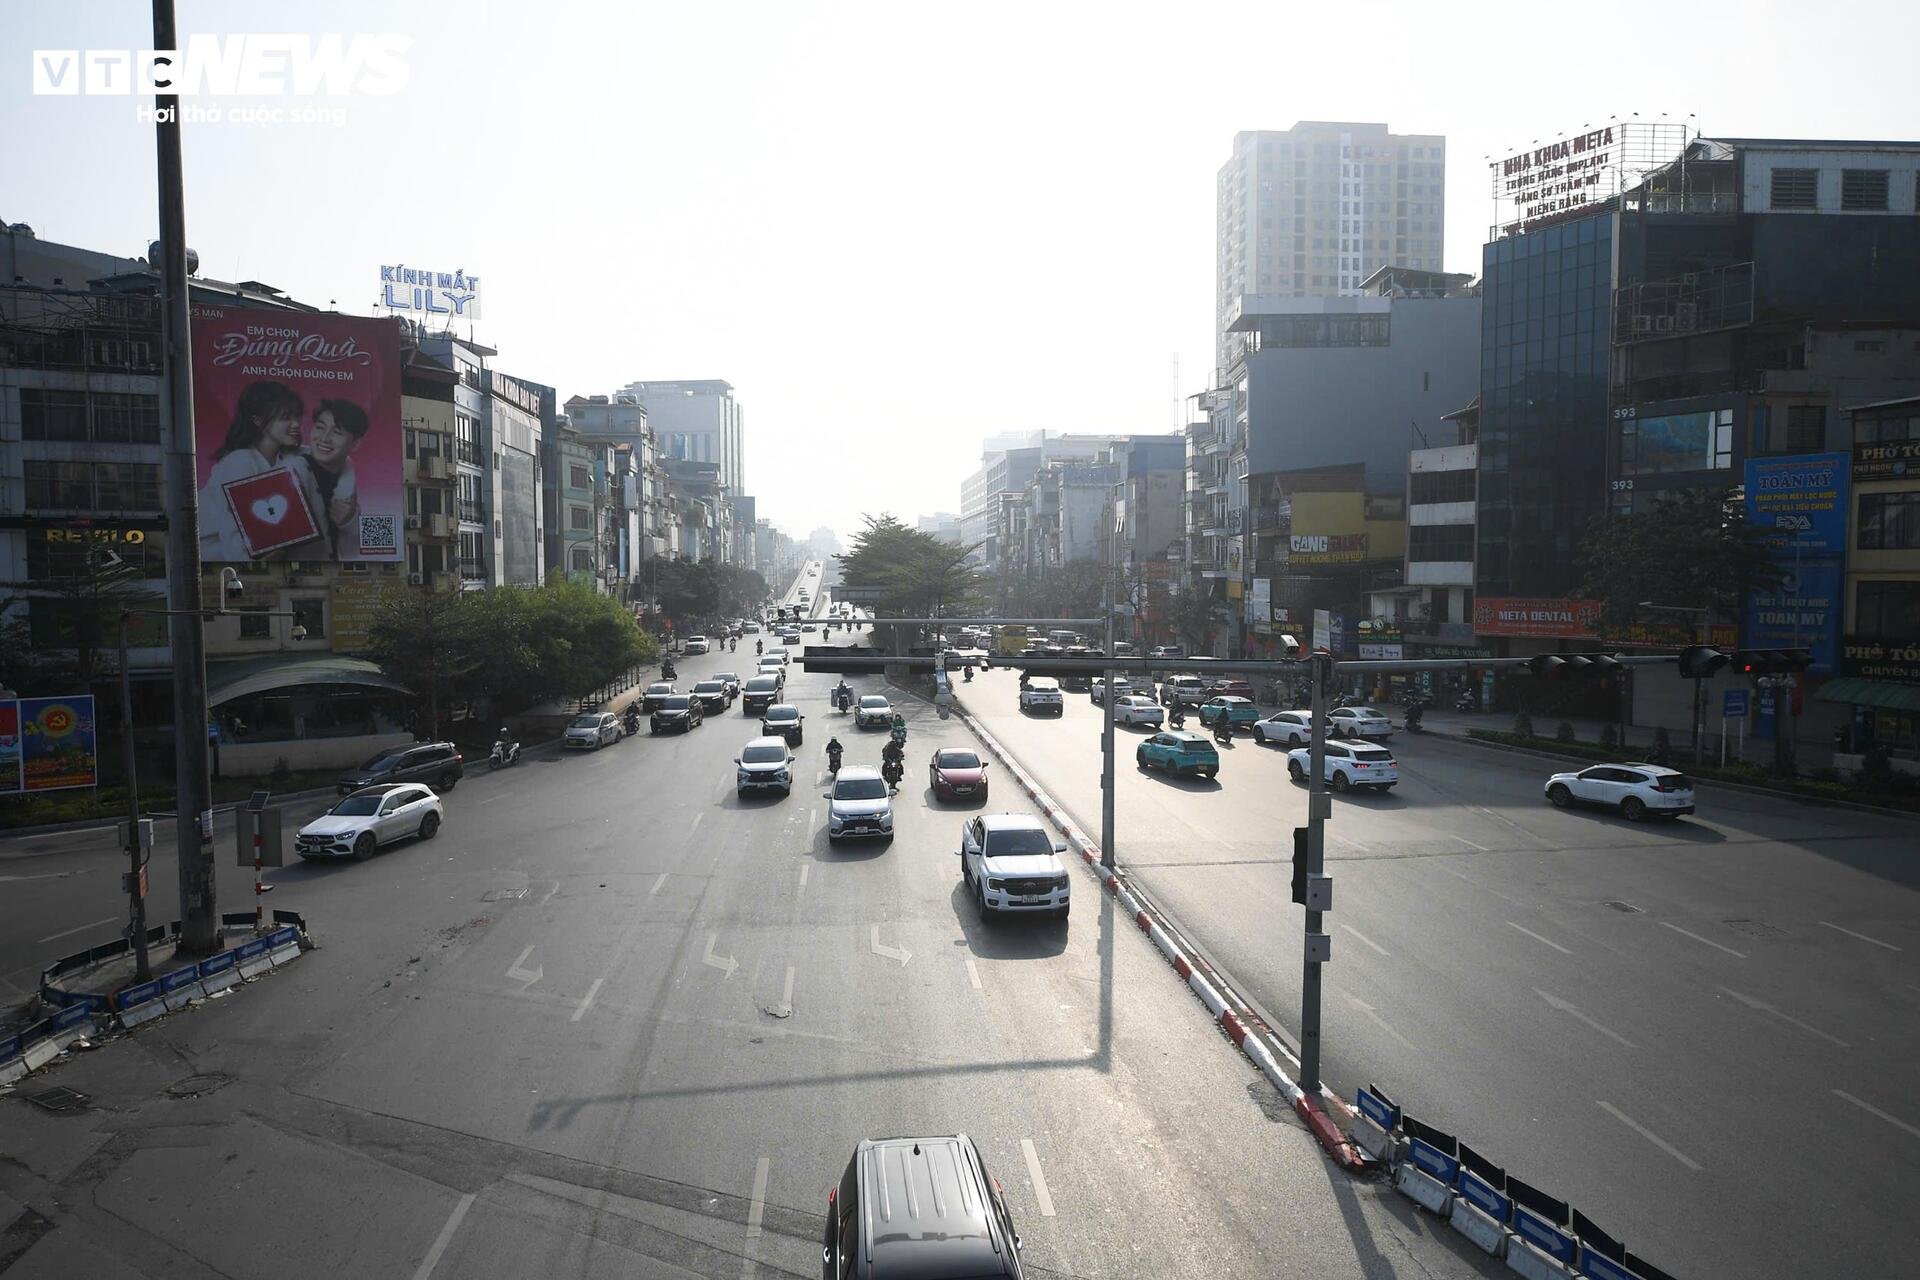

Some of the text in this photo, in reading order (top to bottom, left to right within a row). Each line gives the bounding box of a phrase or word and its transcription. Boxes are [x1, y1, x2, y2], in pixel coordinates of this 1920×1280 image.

[1535, 140, 1570, 167] KHOA
[1574, 127, 1613, 154] META
[381, 264, 479, 291] KÍNH MẮT
[386, 285, 475, 314] LILY
[247, 326, 299, 338] EM CHỌN
[213, 333, 371, 367] Đúng Quà
[242, 365, 266, 377] ANH
[269, 366, 301, 379] CHỌN
[337, 371, 353, 381] EM
[1614, 408, 1636, 418] 393
[1612, 480, 1634, 490] 393
[1776, 515, 1812, 530] FDA
[1290, 535, 1328, 552] GANG
[1498, 610, 1574, 622] META DENTAL
